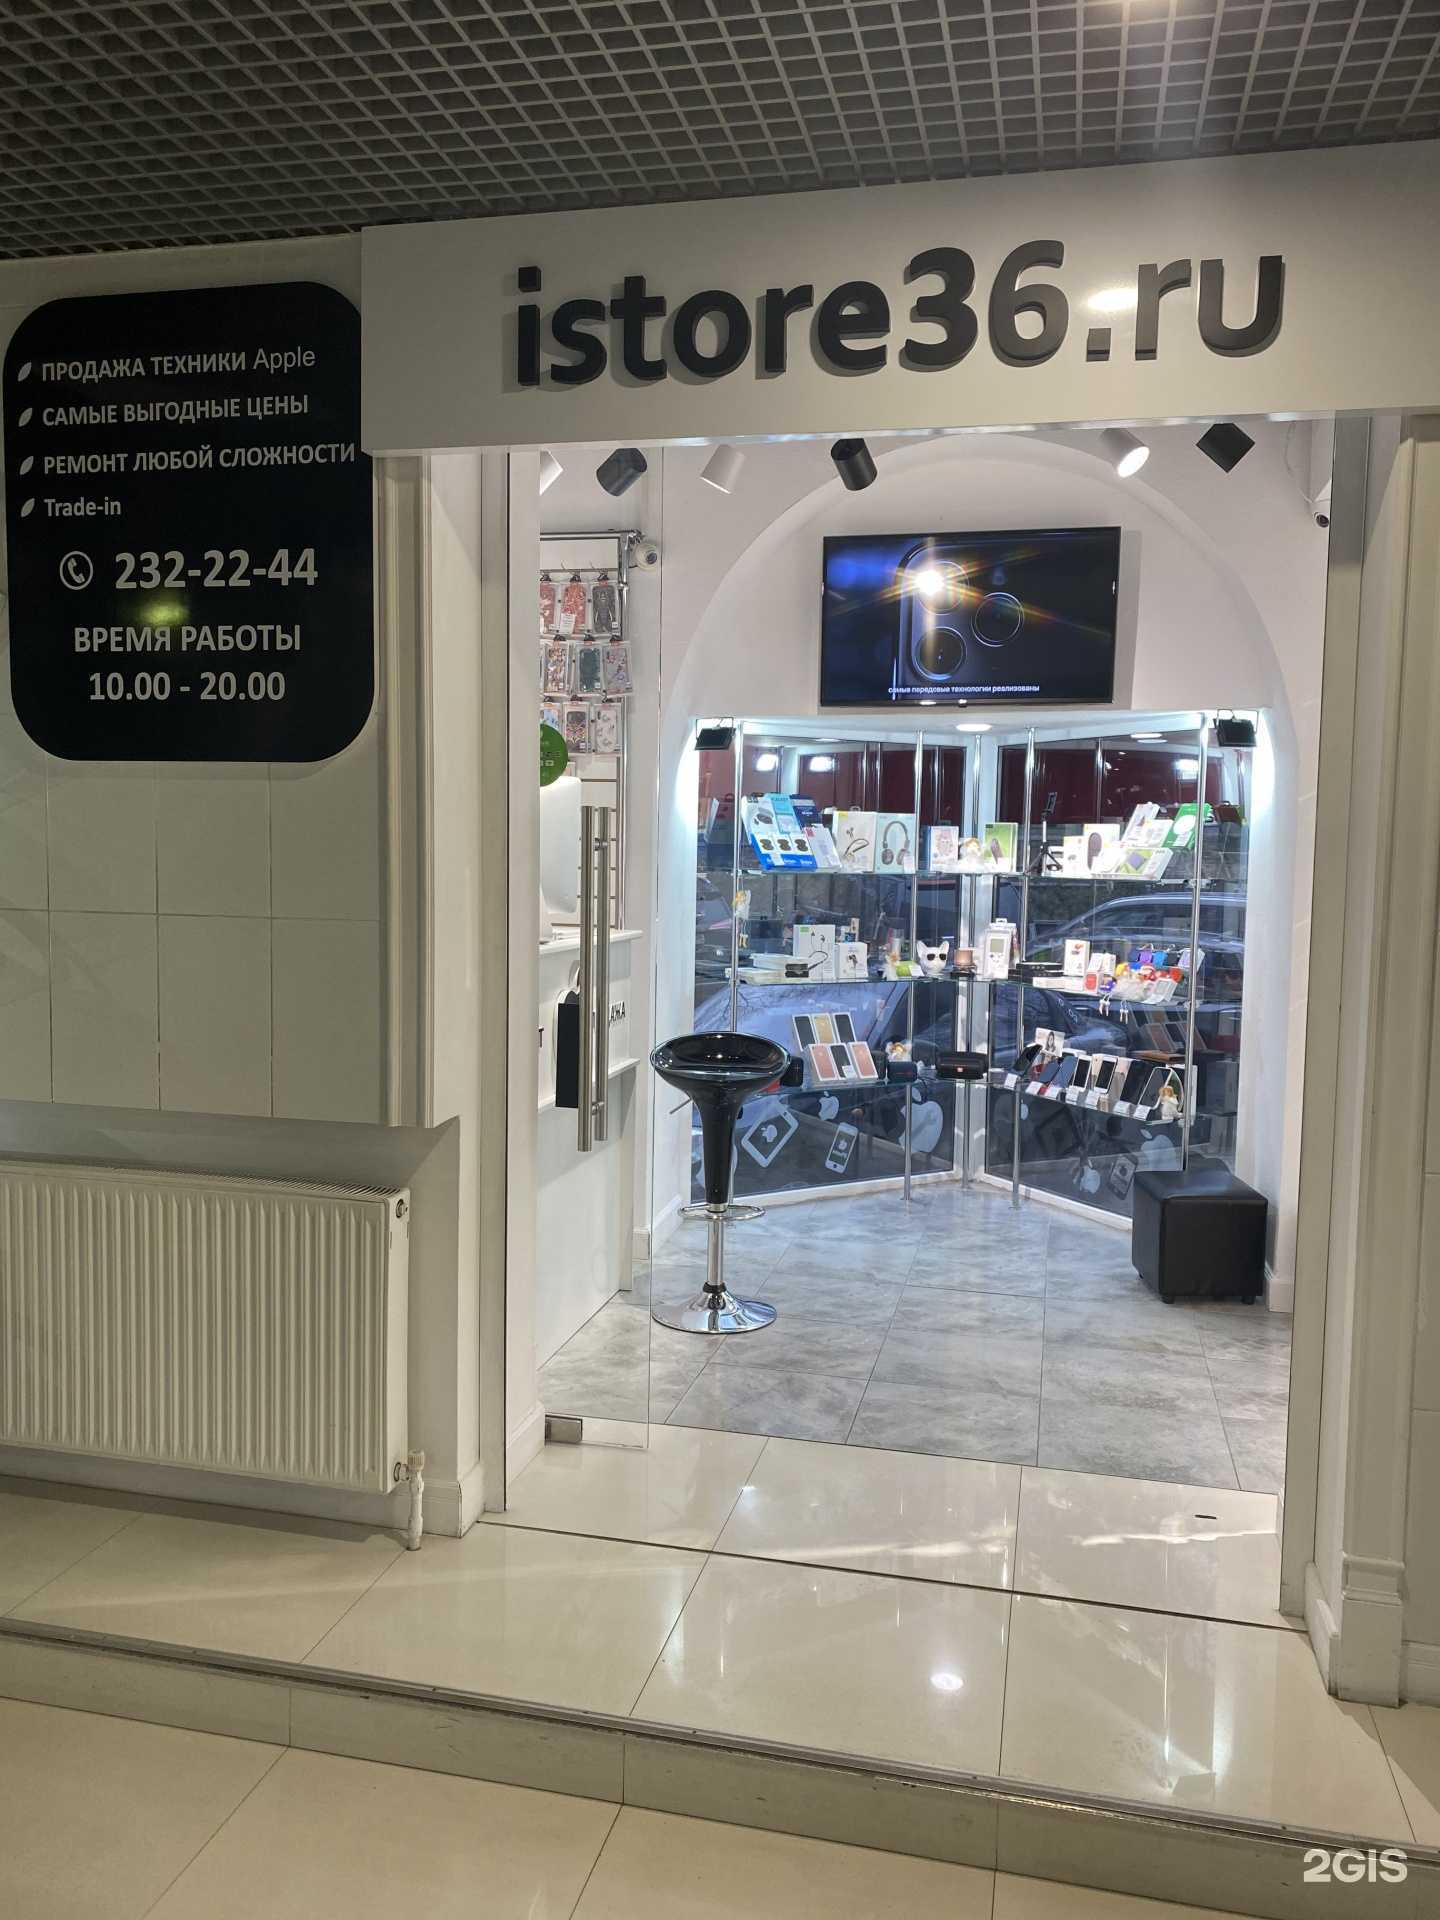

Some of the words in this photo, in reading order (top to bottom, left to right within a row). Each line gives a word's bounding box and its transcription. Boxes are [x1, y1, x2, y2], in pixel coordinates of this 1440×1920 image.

[516, 239, 1285, 386] istore36.ru
[42, 357, 146, 384] ПРОДАЖА
[150, 351, 247, 376] ТЕХНИКИ
[253, 346, 317, 375] Apple
[42, 404, 118, 427] САМЫЕ
[123, 398, 241, 424] ВЫГОДНЫЕ
[247, 394, 309, 421] ЦЕНЫ
[43, 453, 129, 475] РЕМОНТ
[132, 444, 213, 472] ЛЮБОЙ
[219, 442, 356, 468] СЛОЖНОСТИ
[44, 496, 122, 517] Trade-in
[115, 547, 319, 590] 232-22-44
[74, 625, 173, 653] ВРЕМЯ
[180, 623, 301, 652] РАБОТЫ
[89, 671, 171, 701] 10.00
[200, 671, 286, 701] 20.00
